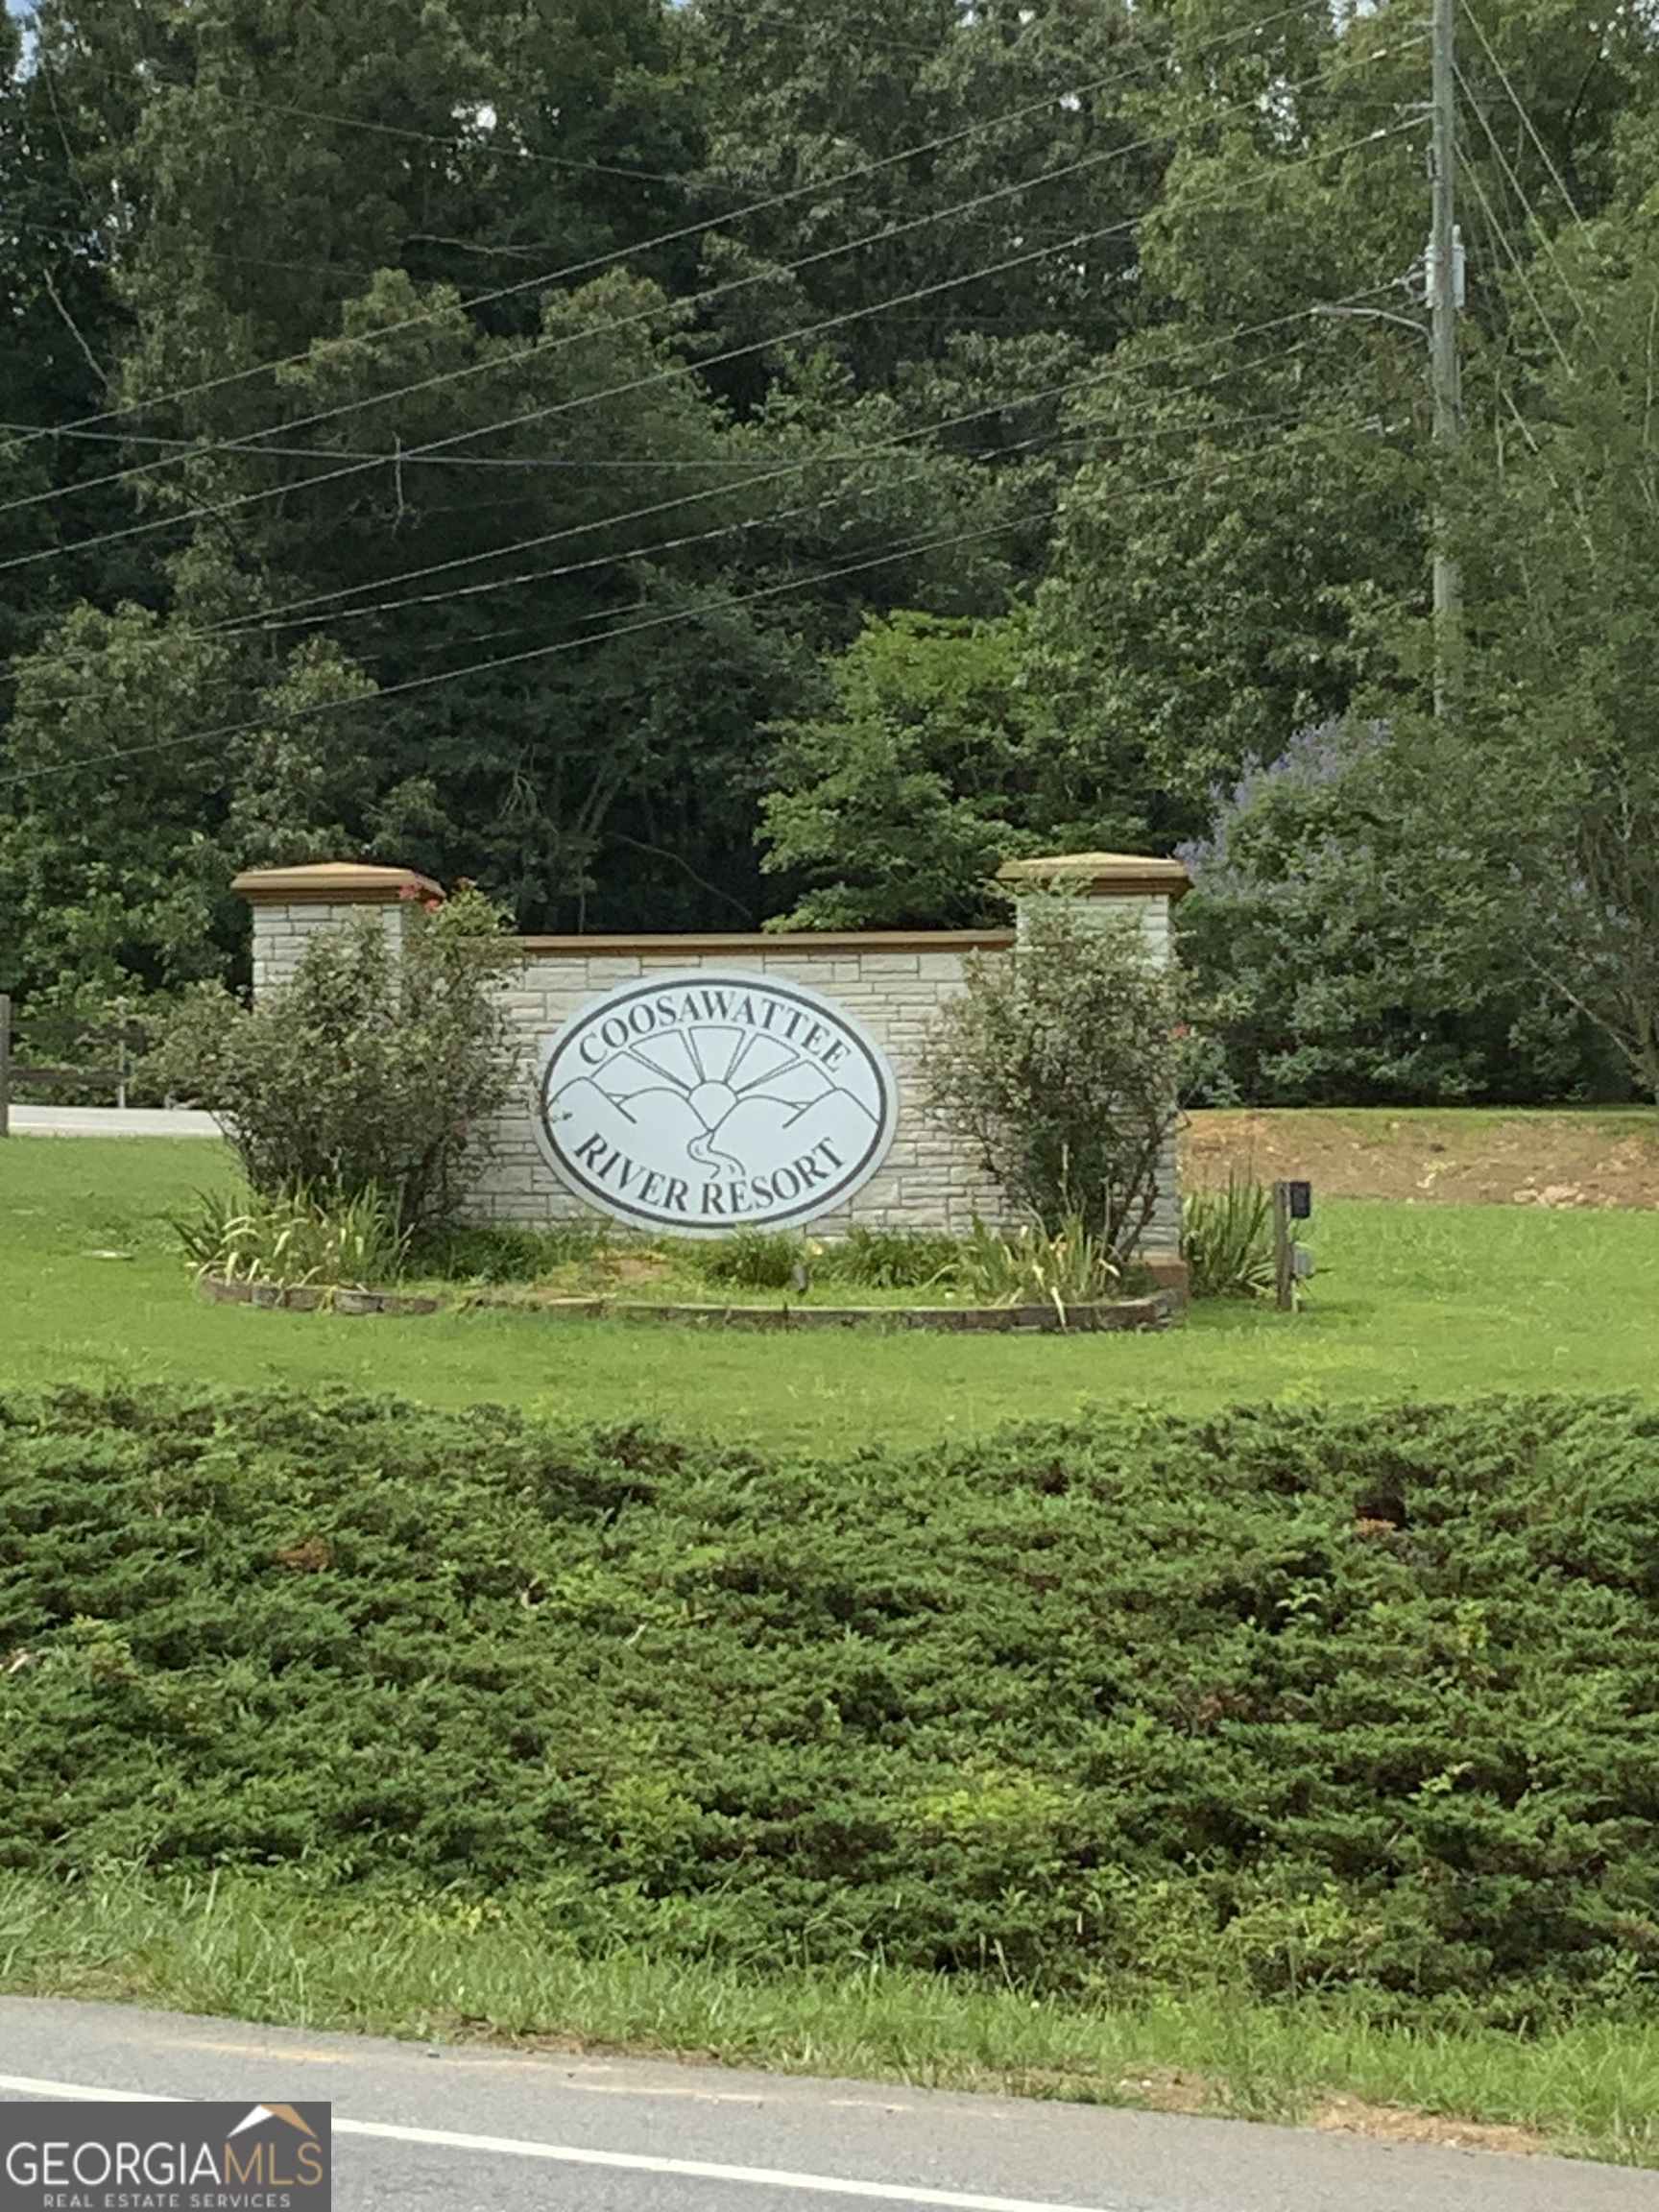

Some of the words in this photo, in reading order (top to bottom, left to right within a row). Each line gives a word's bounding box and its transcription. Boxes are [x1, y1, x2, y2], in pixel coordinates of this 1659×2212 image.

[578, 990, 852, 1073] COOSAWATTEE
[573, 1132, 688, 1213] RIVER
[701, 1136, 846, 1214] RESORT
